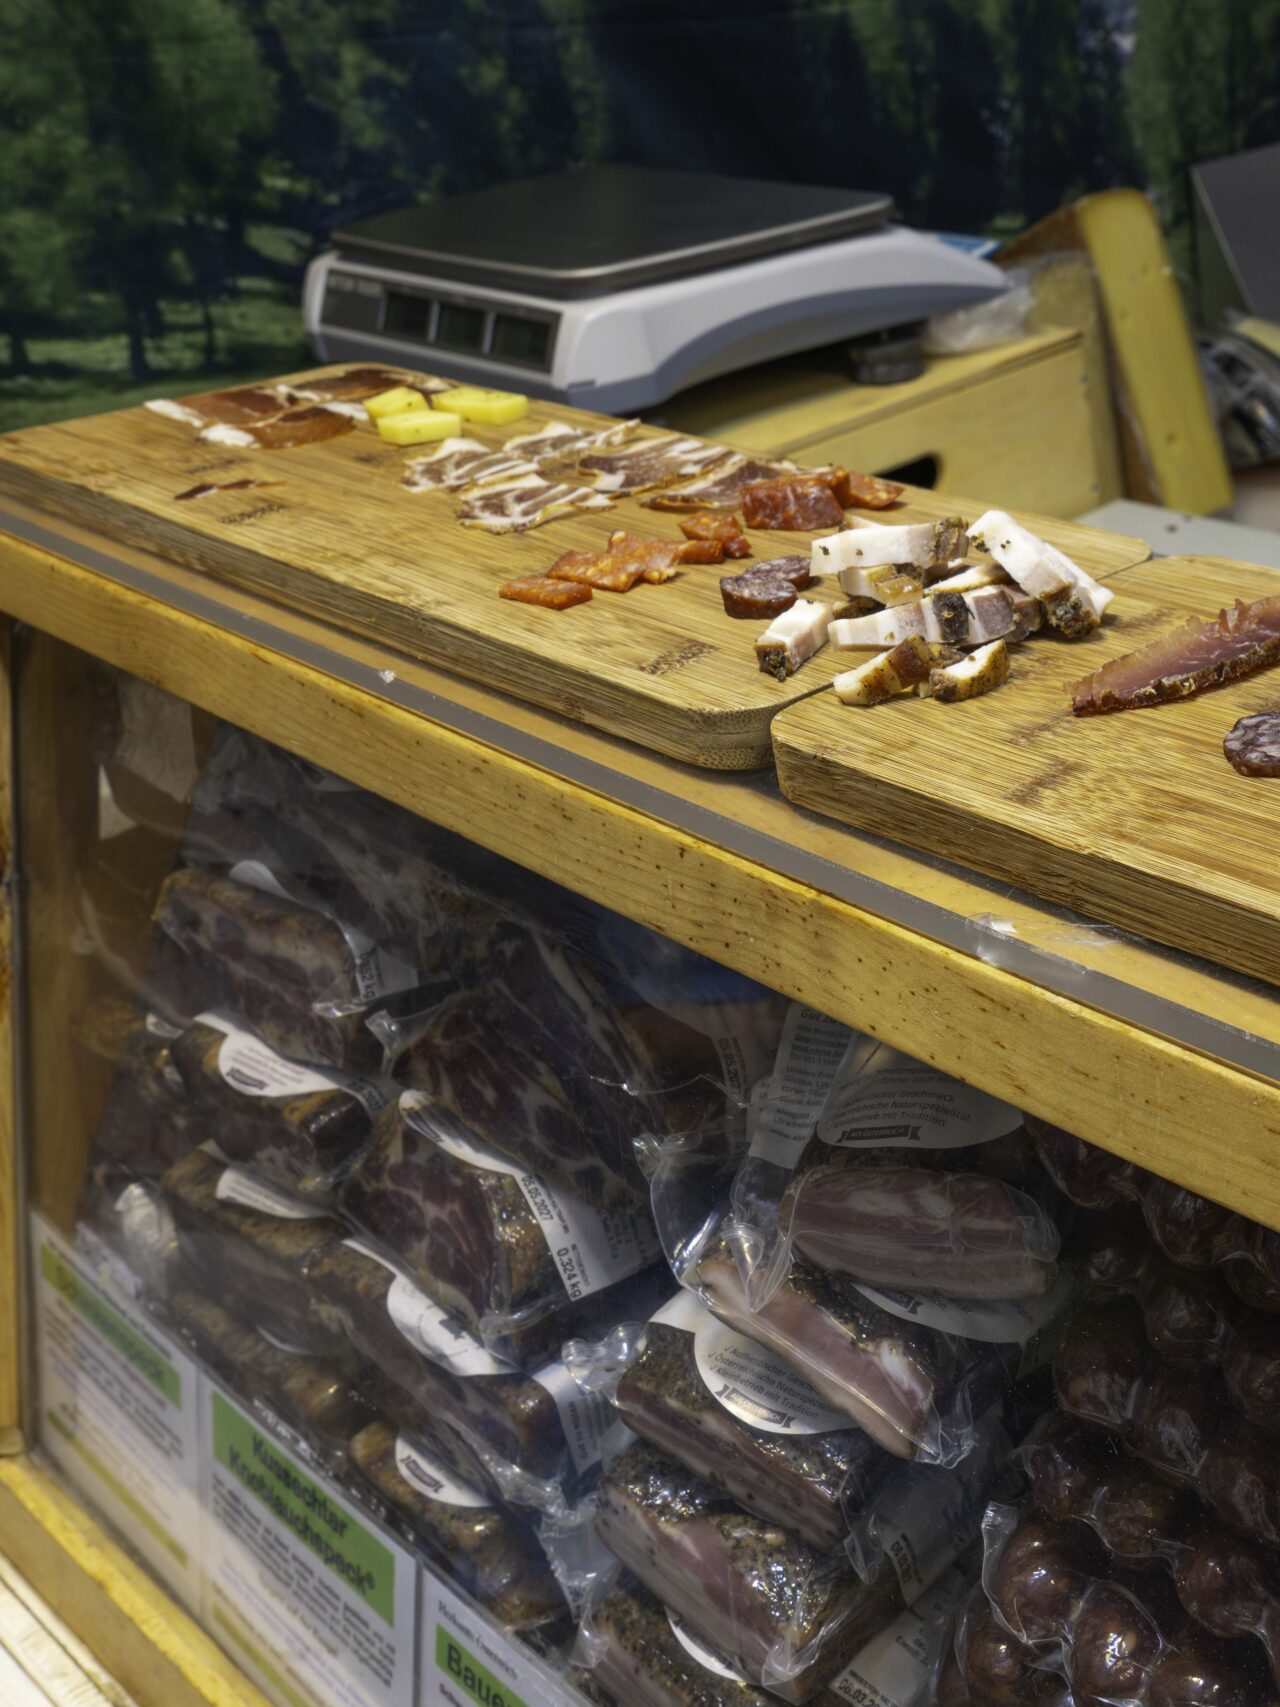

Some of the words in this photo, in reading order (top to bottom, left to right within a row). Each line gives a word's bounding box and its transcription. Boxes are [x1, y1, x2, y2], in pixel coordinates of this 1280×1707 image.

[899, 1089, 956, 1104] Geschmack
[882, 1111, 898, 1121] mit
[900, 1111, 946, 1127] Tradition
[891, 1101, 972, 1123] Naturspezialität
[521, 1175, 554, 1221] 05.05.2027
[557, 1247, 576, 1282] 0.324
[569, 1280, 583, 1299] kg
[782, 1398, 819, 1419] Tradition
